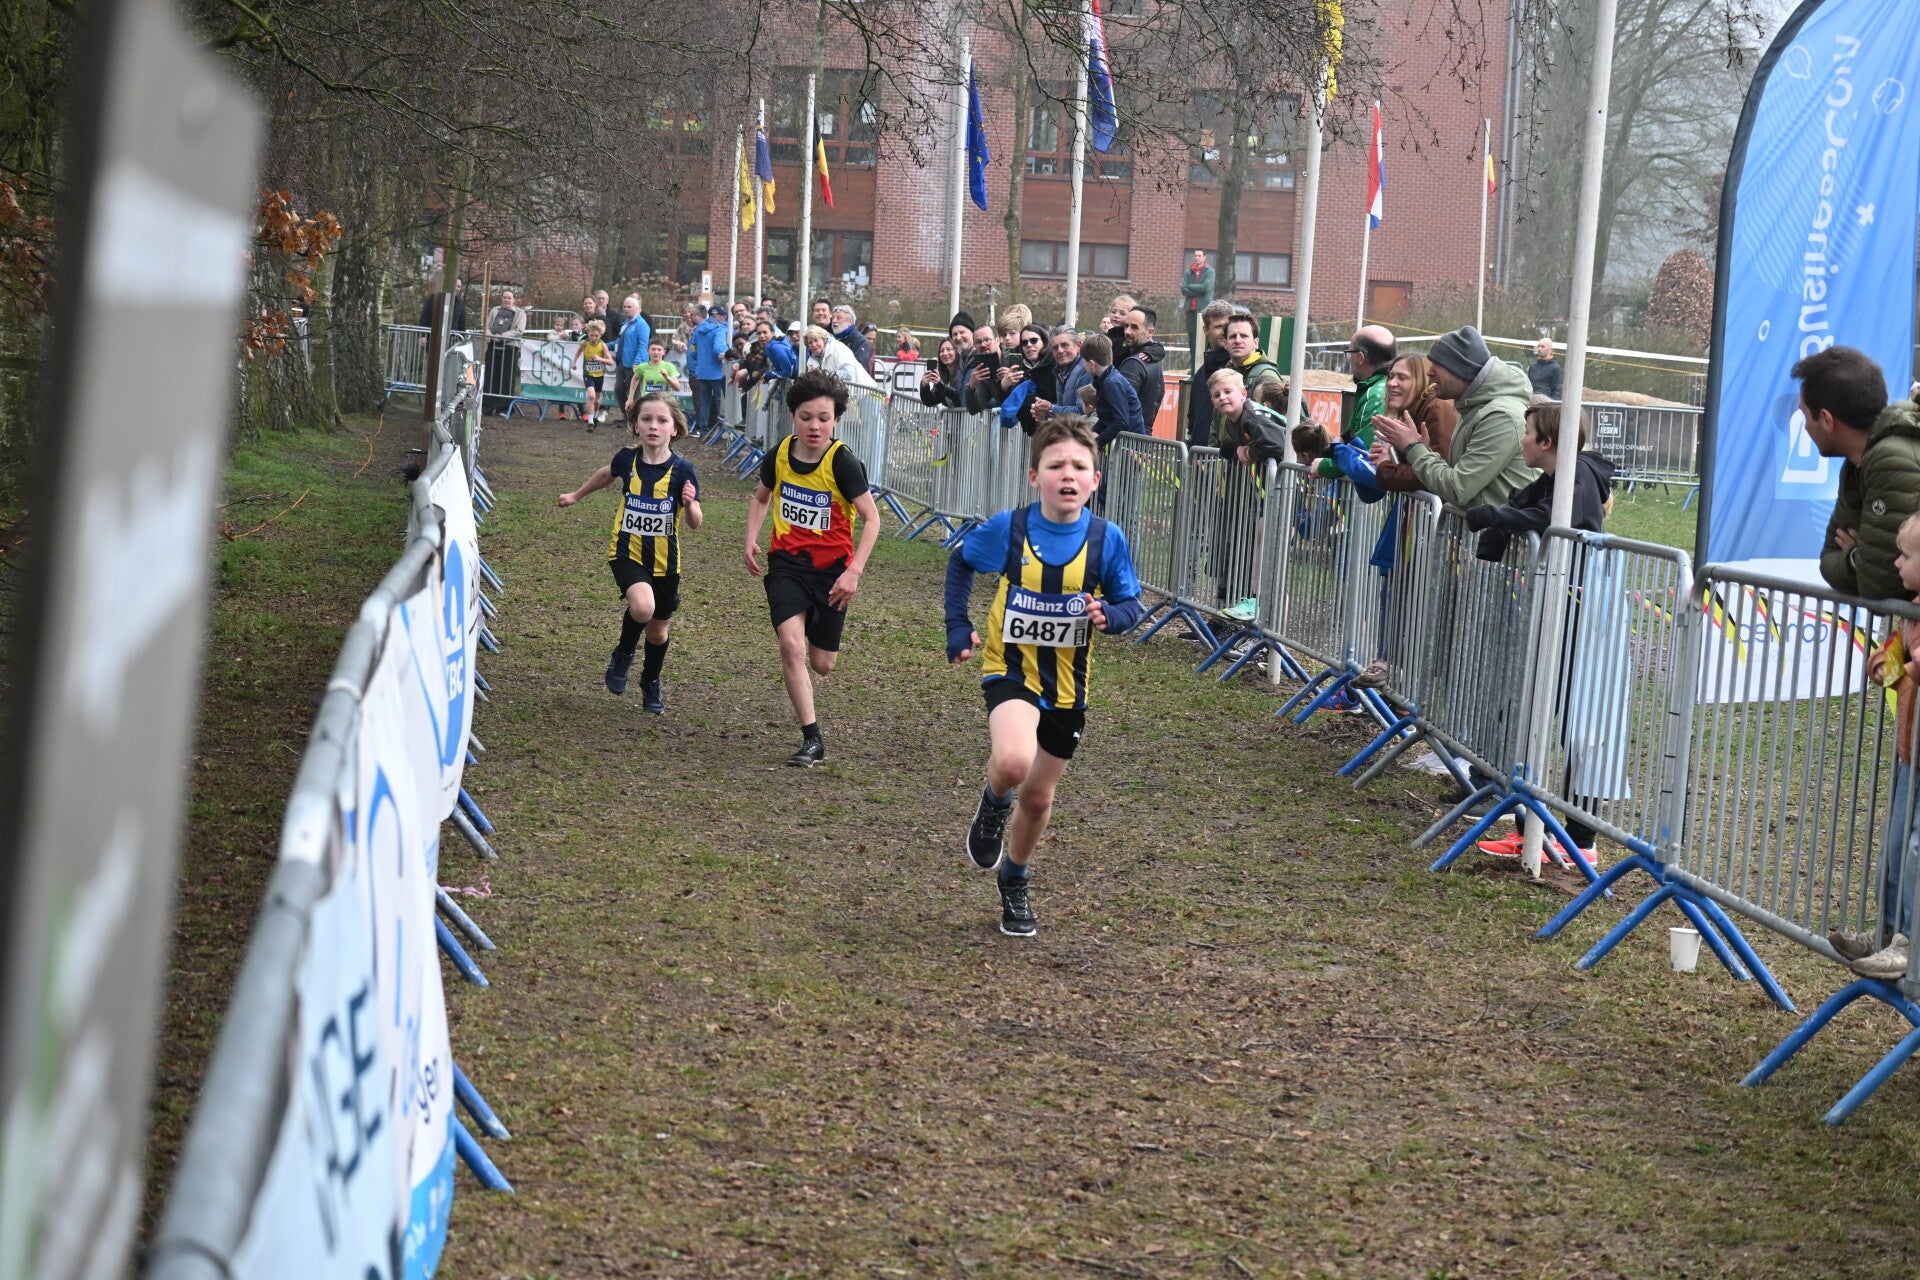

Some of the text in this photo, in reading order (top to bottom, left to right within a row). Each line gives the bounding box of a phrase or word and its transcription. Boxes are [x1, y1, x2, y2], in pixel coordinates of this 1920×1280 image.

[626, 496, 658, 512] Allianz
[781, 485, 814, 503] Allianz
[625, 513, 663, 533] 6482
[782, 502, 819, 526] 6567
[1011, 592, 1064, 613] Allianz
[1009, 617, 1072, 643] 6487
